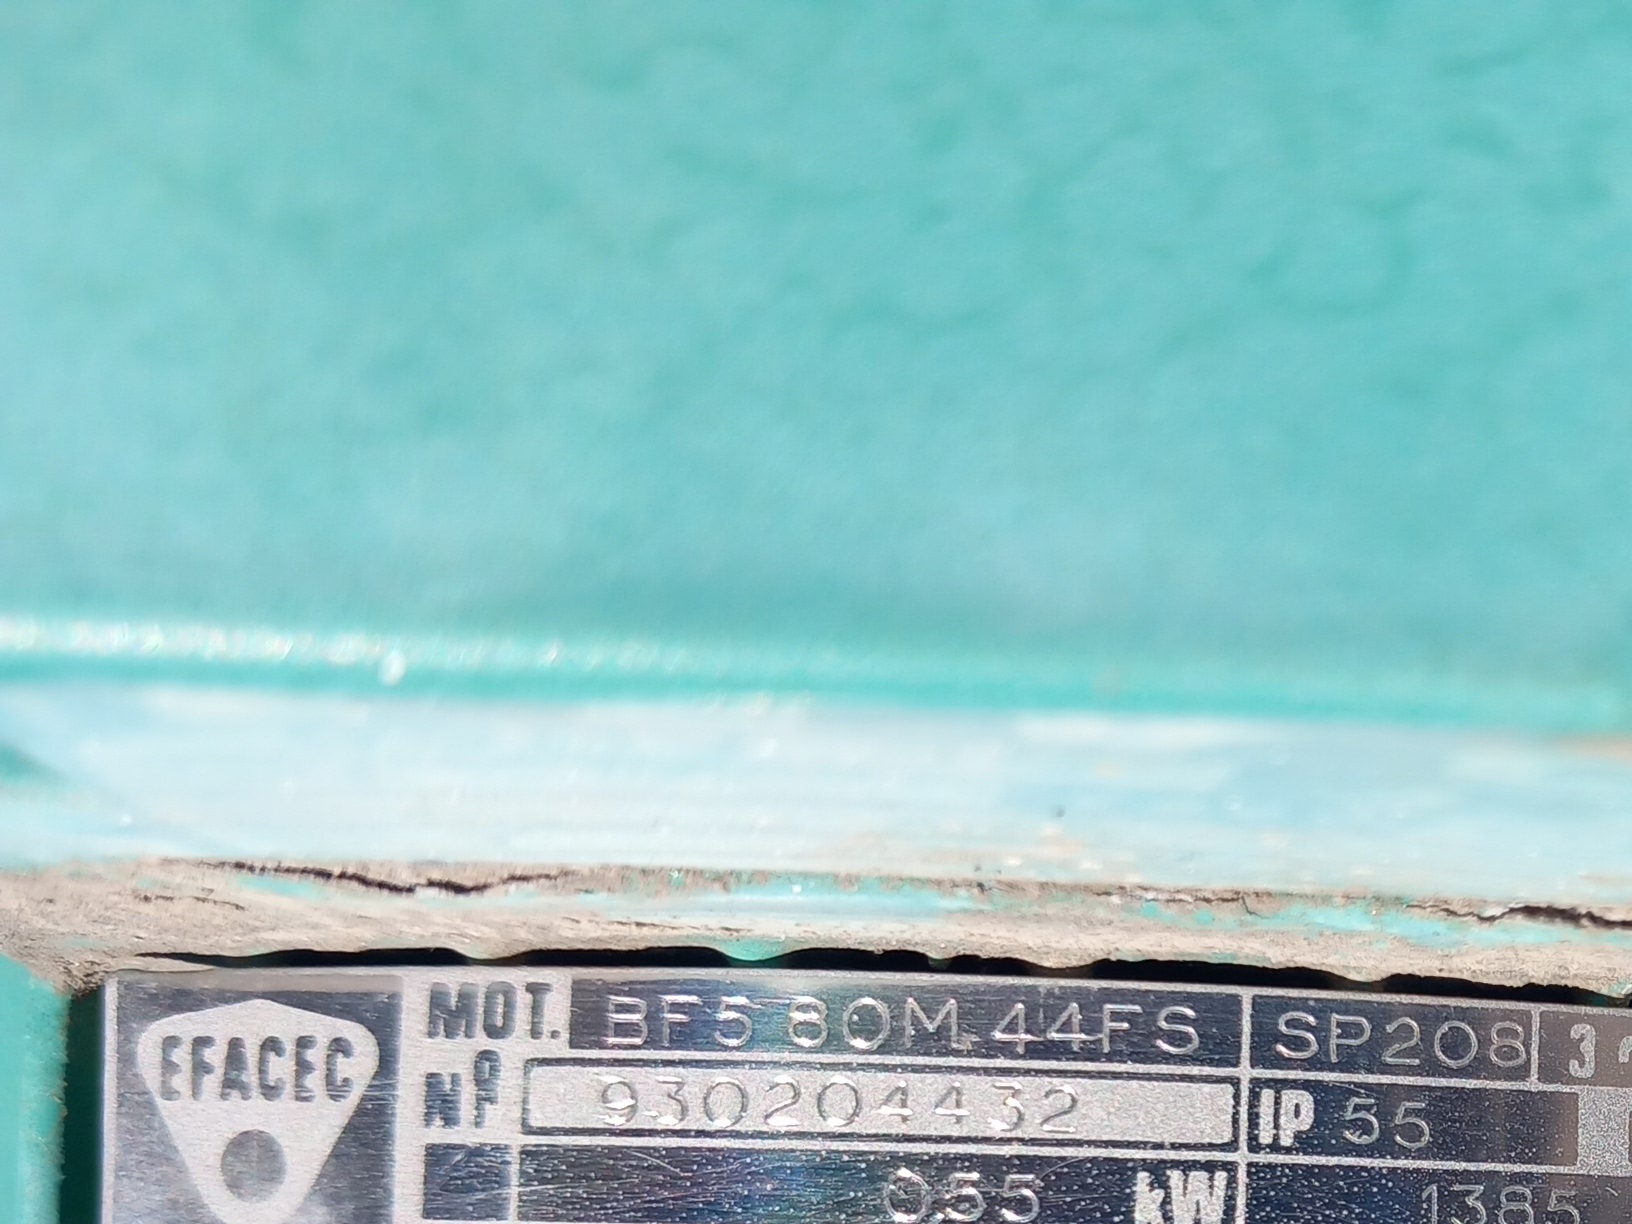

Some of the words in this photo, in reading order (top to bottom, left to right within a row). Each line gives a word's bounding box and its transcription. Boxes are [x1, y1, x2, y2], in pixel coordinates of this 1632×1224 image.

[429, 981, 561, 1040] MOT.
[1275, 1011, 1528, 1069] SP208
[161, 1034, 355, 1102] EFACEC
[1569, 1023, 1597, 1079] 3
[596, 1073, 1079, 1133] 930204432
[1258, 1088, 1315, 1147] IP
[1343, 1097, 1432, 1150] 55
